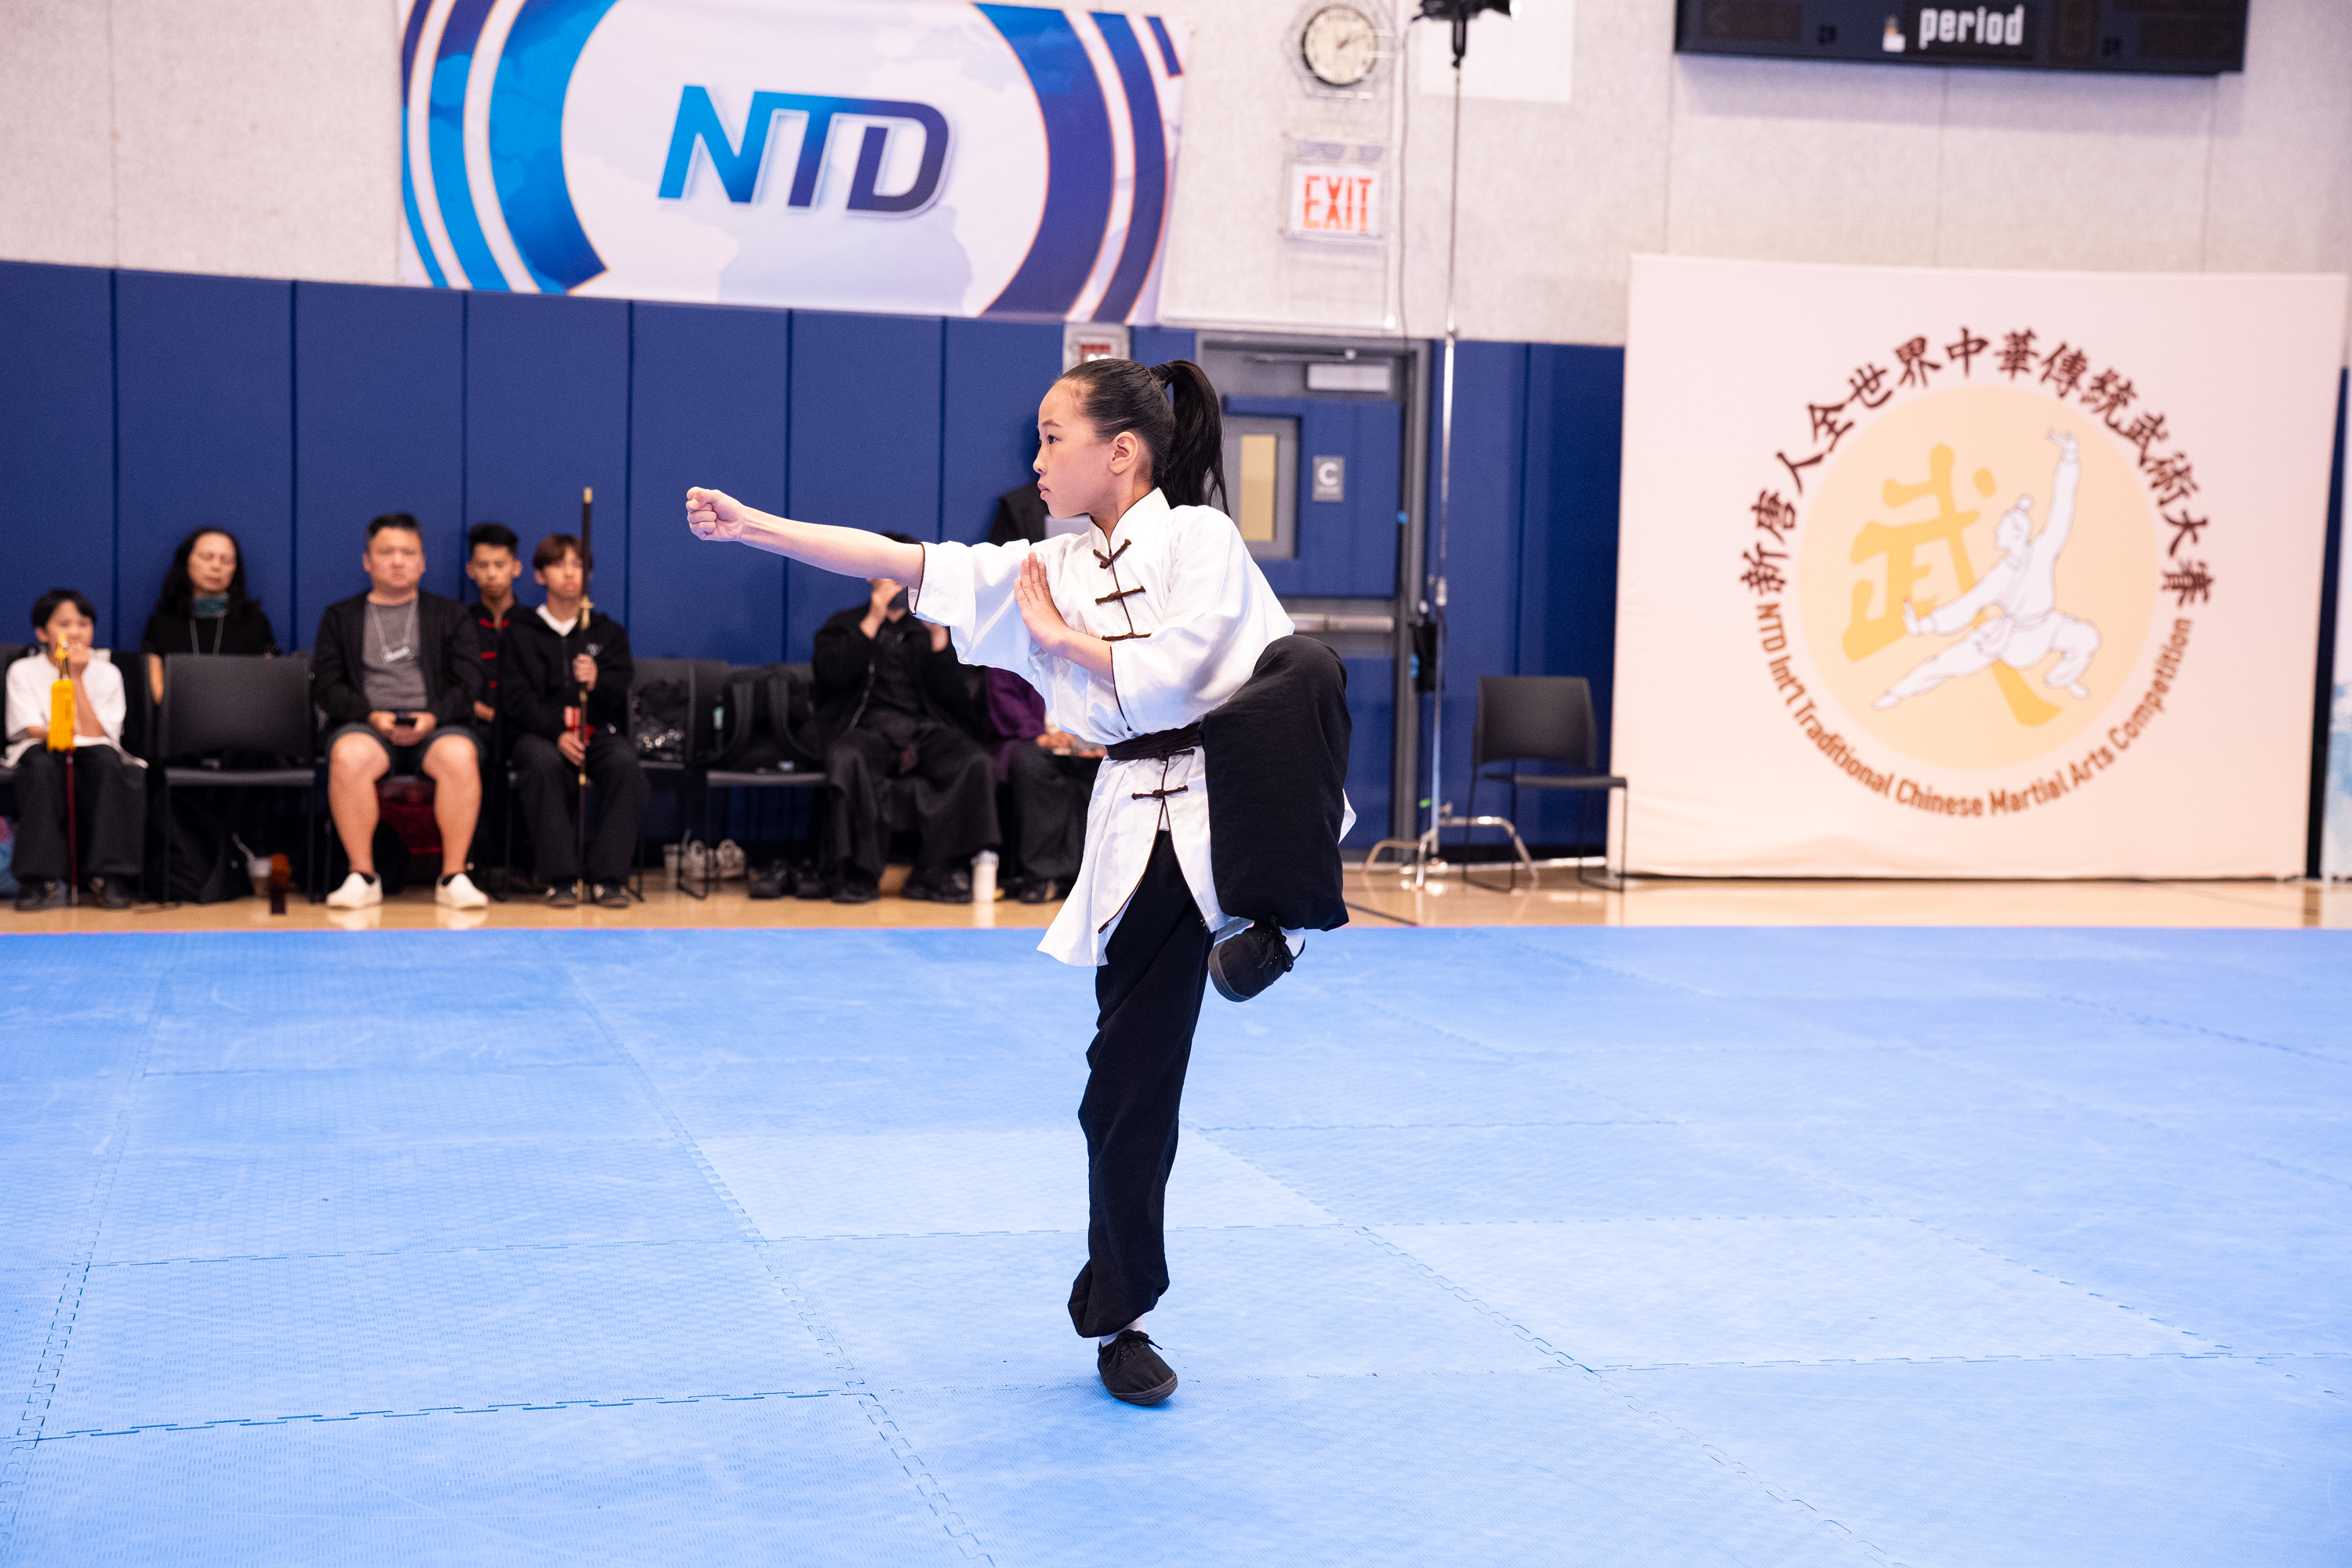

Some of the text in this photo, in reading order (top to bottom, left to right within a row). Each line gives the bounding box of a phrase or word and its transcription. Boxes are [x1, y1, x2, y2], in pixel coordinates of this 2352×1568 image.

[1919, 4, 2025, 50] period
[657, 83, 951, 217] NTD
[1304, 174, 1372, 232] EXIT
[1318, 462, 1339, 486] C
[1756, 603, 1787, 653] NTD
[1793, 699, 1895, 798] Traditional
[1895, 778, 1984, 817] Chinese
[1988, 769, 2070, 816] Martial
[2068, 745, 2116, 788] Arts
[2107, 617, 2193, 750] Competition
